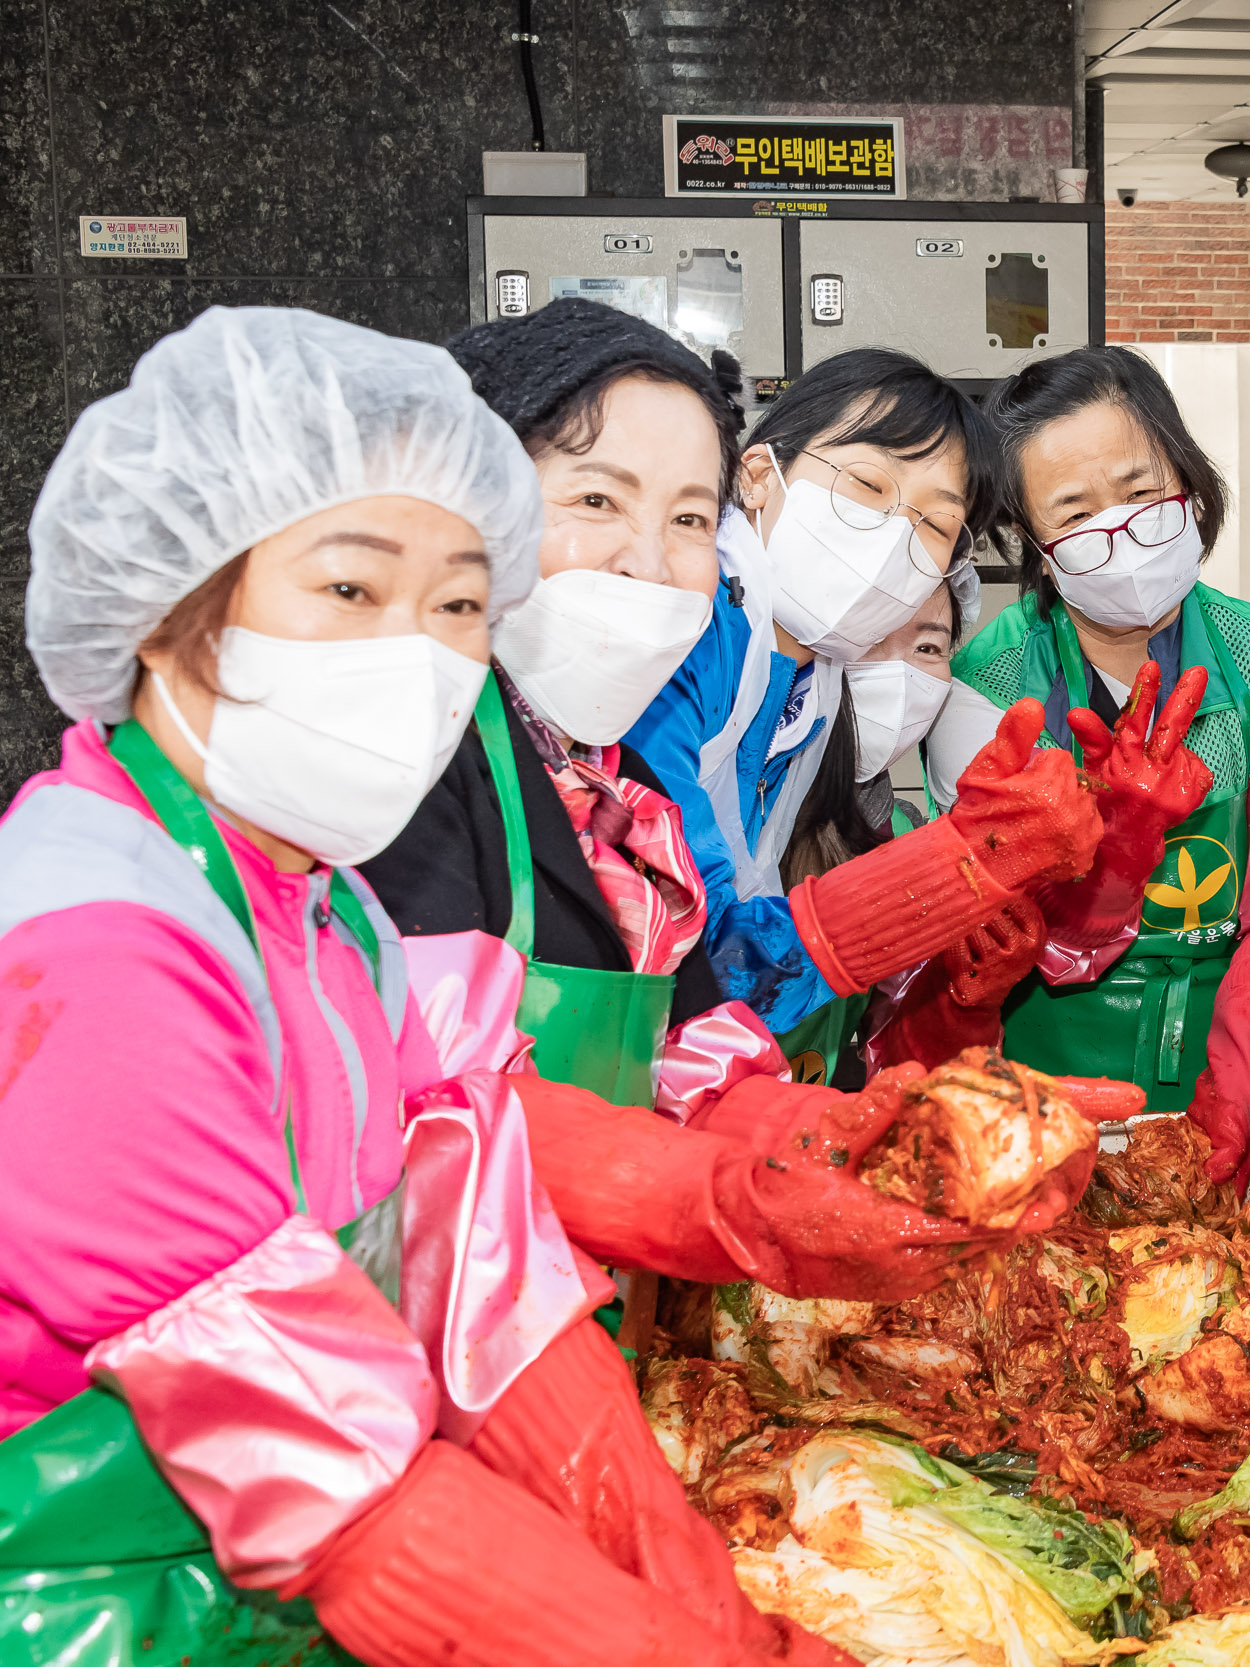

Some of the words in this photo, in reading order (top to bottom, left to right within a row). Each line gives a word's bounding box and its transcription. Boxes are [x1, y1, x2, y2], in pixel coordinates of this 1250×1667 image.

[735, 137, 894, 177] 무인택배보관함
[776, 202, 828, 212] 무인택배함
[107, 223, 178, 233] 광고물부착금지
[614, 239, 640, 249] 01
[925, 242, 954, 252] 02
